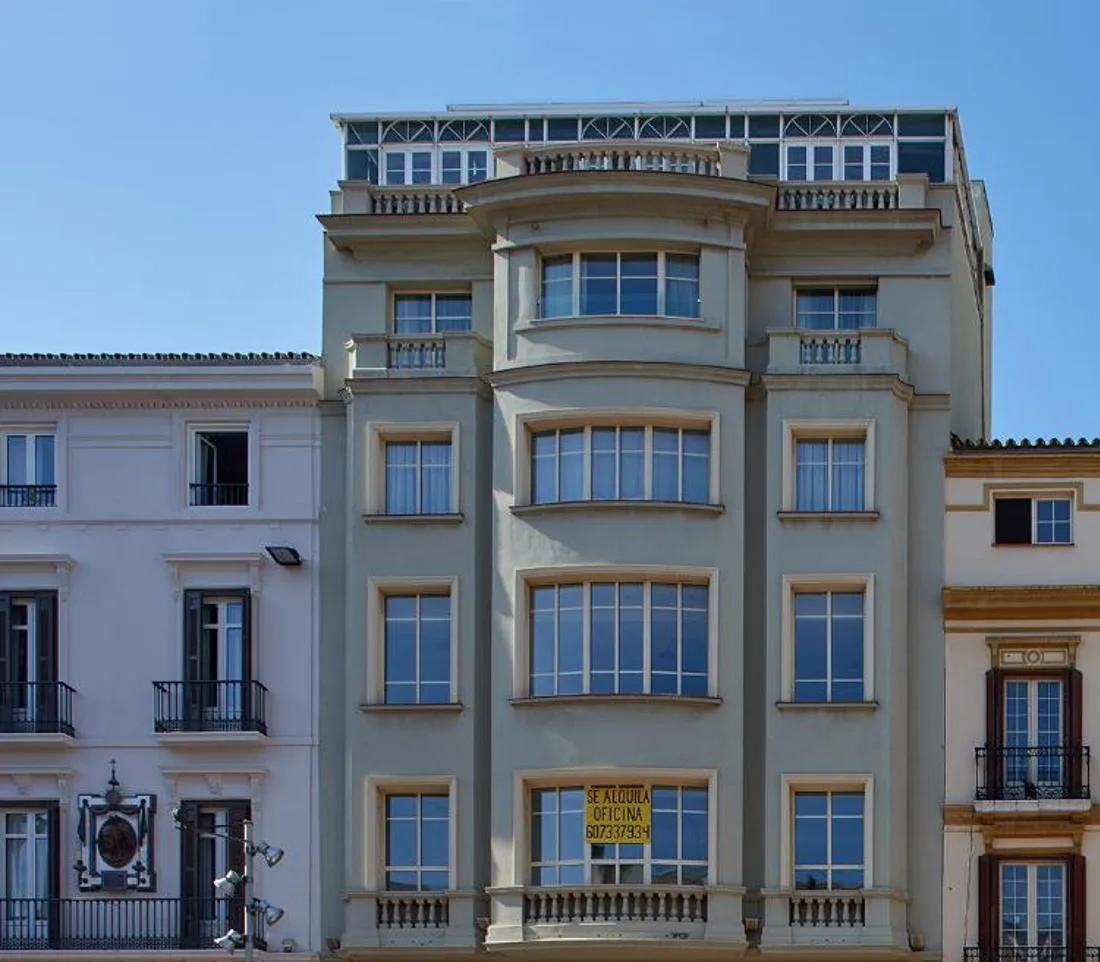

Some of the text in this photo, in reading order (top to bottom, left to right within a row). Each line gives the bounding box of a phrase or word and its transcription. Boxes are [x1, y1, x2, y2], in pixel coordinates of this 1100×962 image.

[587, 789, 651, 804] SE ALQUILA
[593, 806, 643, 821] OFICINA
